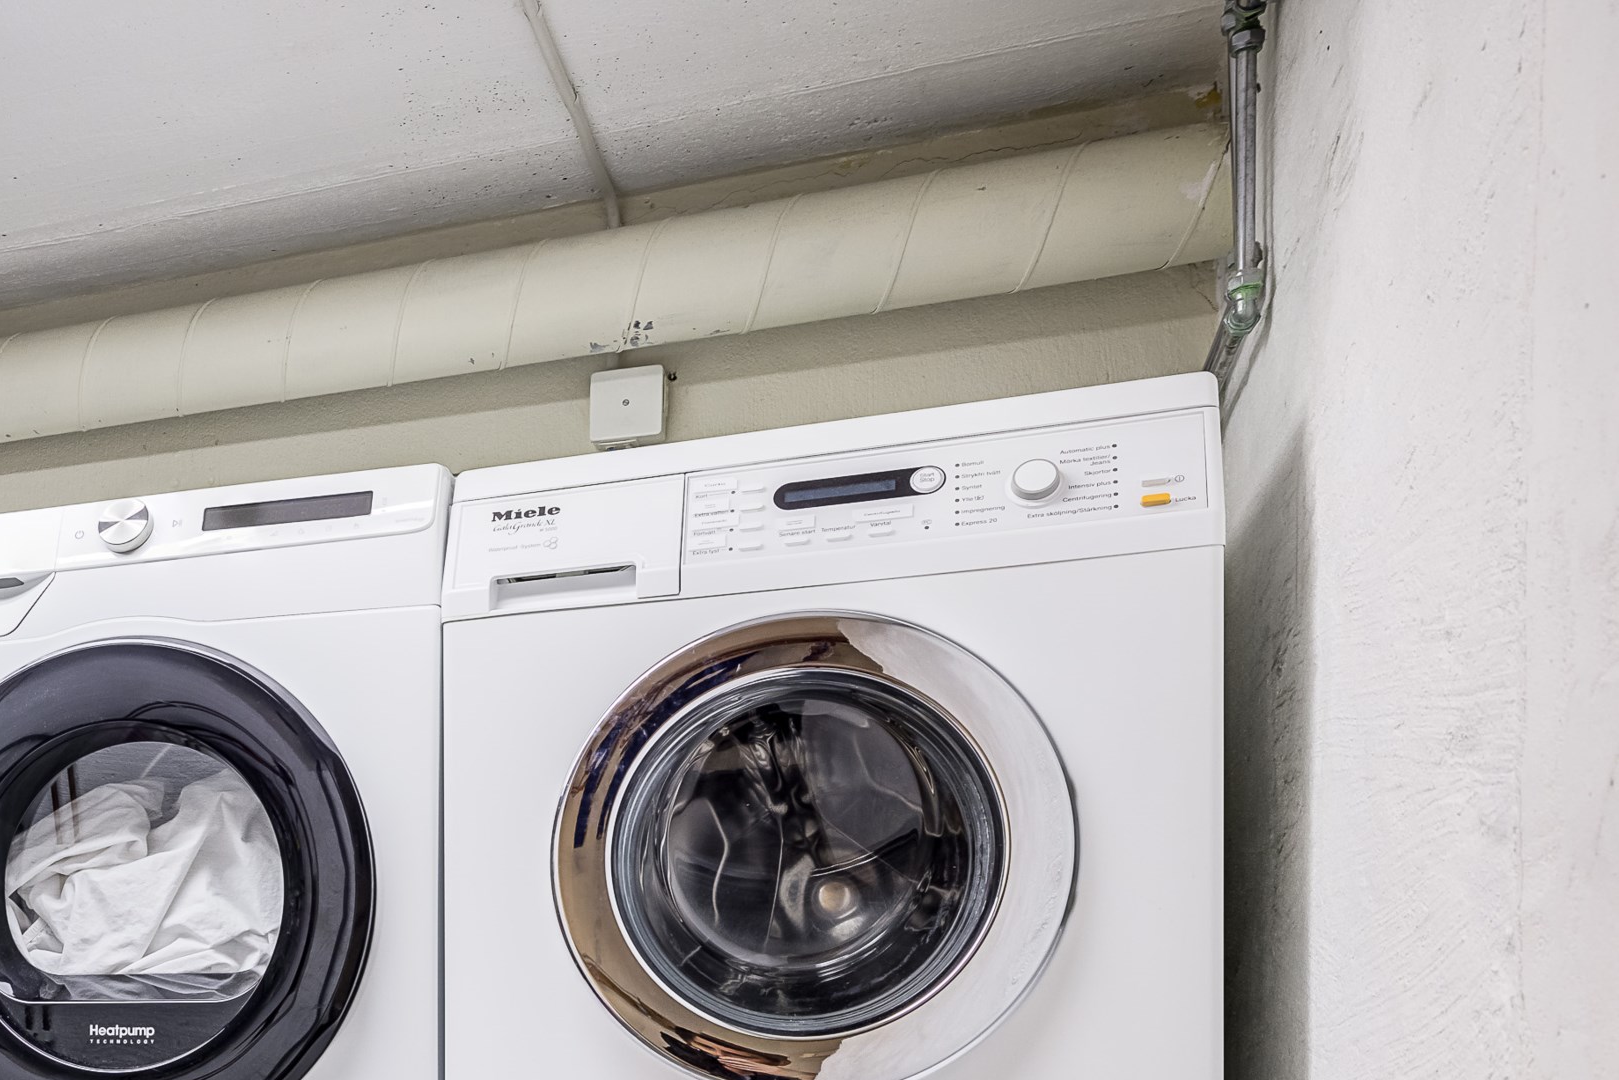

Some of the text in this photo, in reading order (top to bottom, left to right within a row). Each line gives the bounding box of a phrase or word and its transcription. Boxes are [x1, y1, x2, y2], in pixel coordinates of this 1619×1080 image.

[1175, 495, 1197, 503] Lucka
[491, 505, 561, 522] Miele
[89, 1024, 155, 1039] Heatpump
